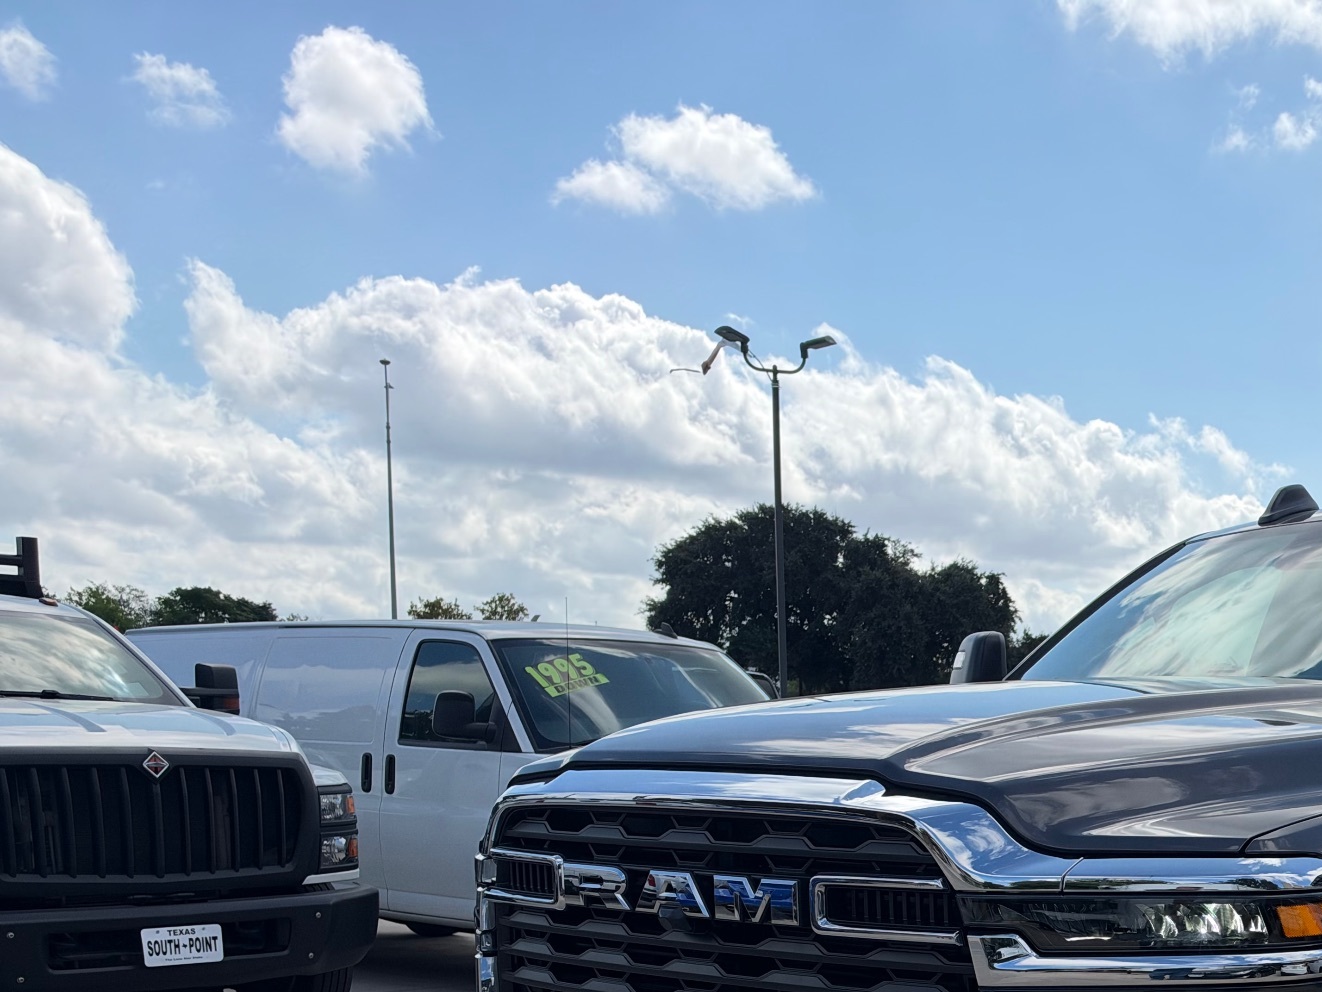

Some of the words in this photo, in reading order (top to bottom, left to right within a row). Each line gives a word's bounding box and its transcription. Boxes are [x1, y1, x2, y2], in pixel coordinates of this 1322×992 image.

[525, 653, 596, 688] 1995
[554, 676, 600, 693] DOWN
[564, 862, 800, 926] RAM
[167, 928, 196, 936] TEXAS
[147, 939, 181, 957] SOUTH
[188, 936, 218, 954] POINT
